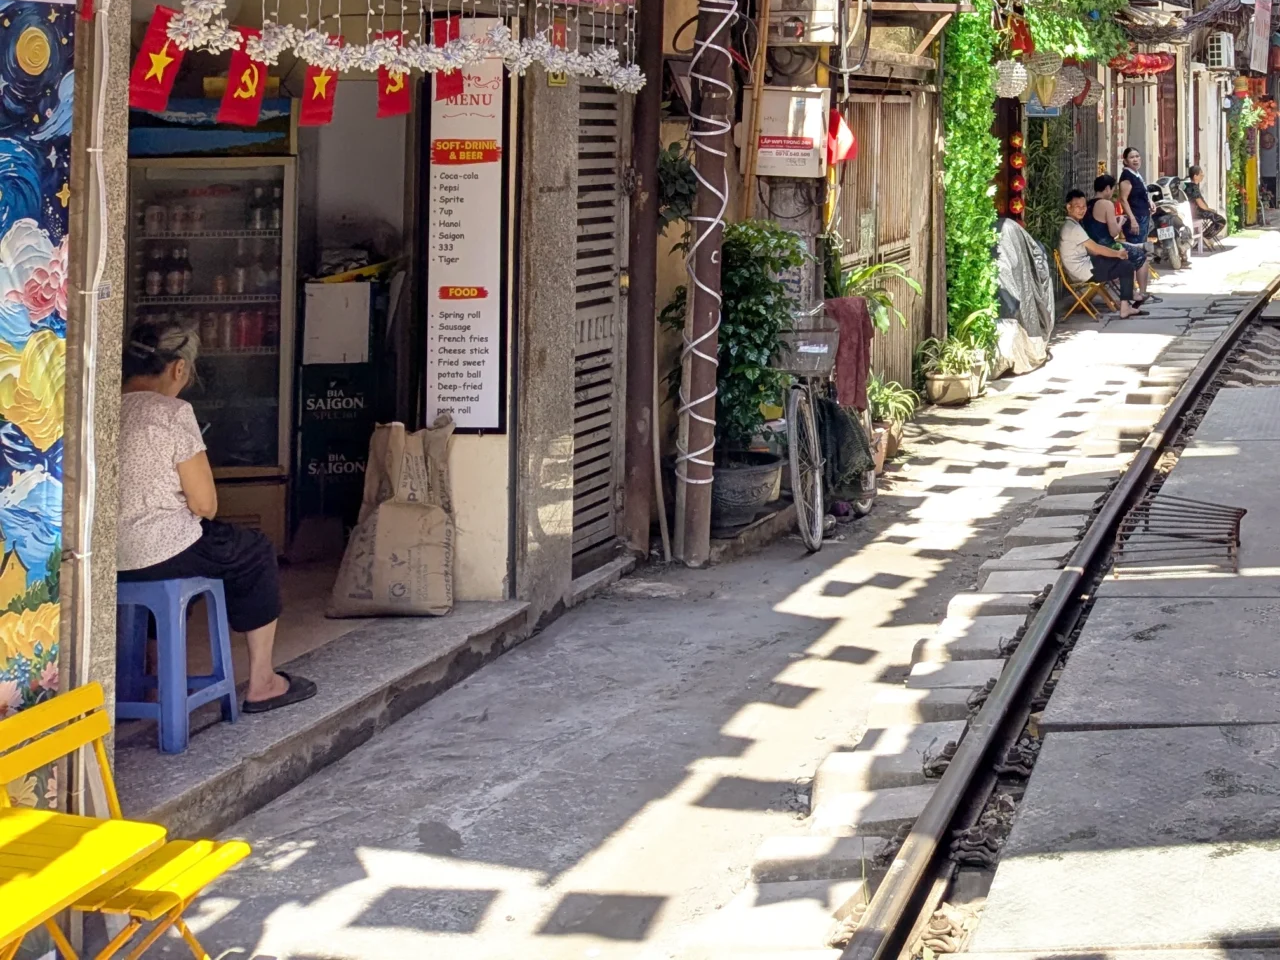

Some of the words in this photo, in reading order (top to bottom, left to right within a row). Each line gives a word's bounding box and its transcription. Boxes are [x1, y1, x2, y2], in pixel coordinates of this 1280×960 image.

[445, 93, 493, 106] MENU
[436, 141, 497, 150] SOFT-DRINK
[449, 151, 457, 160] &
[459, 151, 483, 160] BEER
[439, 172, 479, 180] Coca-cola
[439, 184, 460, 193] Pepsi
[439, 196, 464, 205] Sprite
[439, 208, 453, 216] 7up
[438, 232, 465, 241] Saigon
[438, 243, 454, 251] 333
[438, 255, 460, 265] Tiger
[449, 288, 478, 296] FOOD
[439, 311, 464, 320] Spring
[438, 323, 471, 332] Sausage
[438, 334, 466, 342] French
[469, 334, 489, 342] fries
[438, 346, 466, 354] Cheese
[469, 346, 489, 354] stick
[438, 358, 459, 366] Fried
[437, 371, 463, 380] potato
[467, 370, 481, 378] ball
[437, 382, 482, 391] Deep-fried
[327, 389, 345, 397] BIA
[437, 394, 479, 402] fermented
[306, 397, 364, 410] SAIGON
[437, 407, 454, 416] pork
[458, 406, 471, 414] roll
[328, 453, 346, 461] BIA
[308, 461, 365, 474] SAIGON
